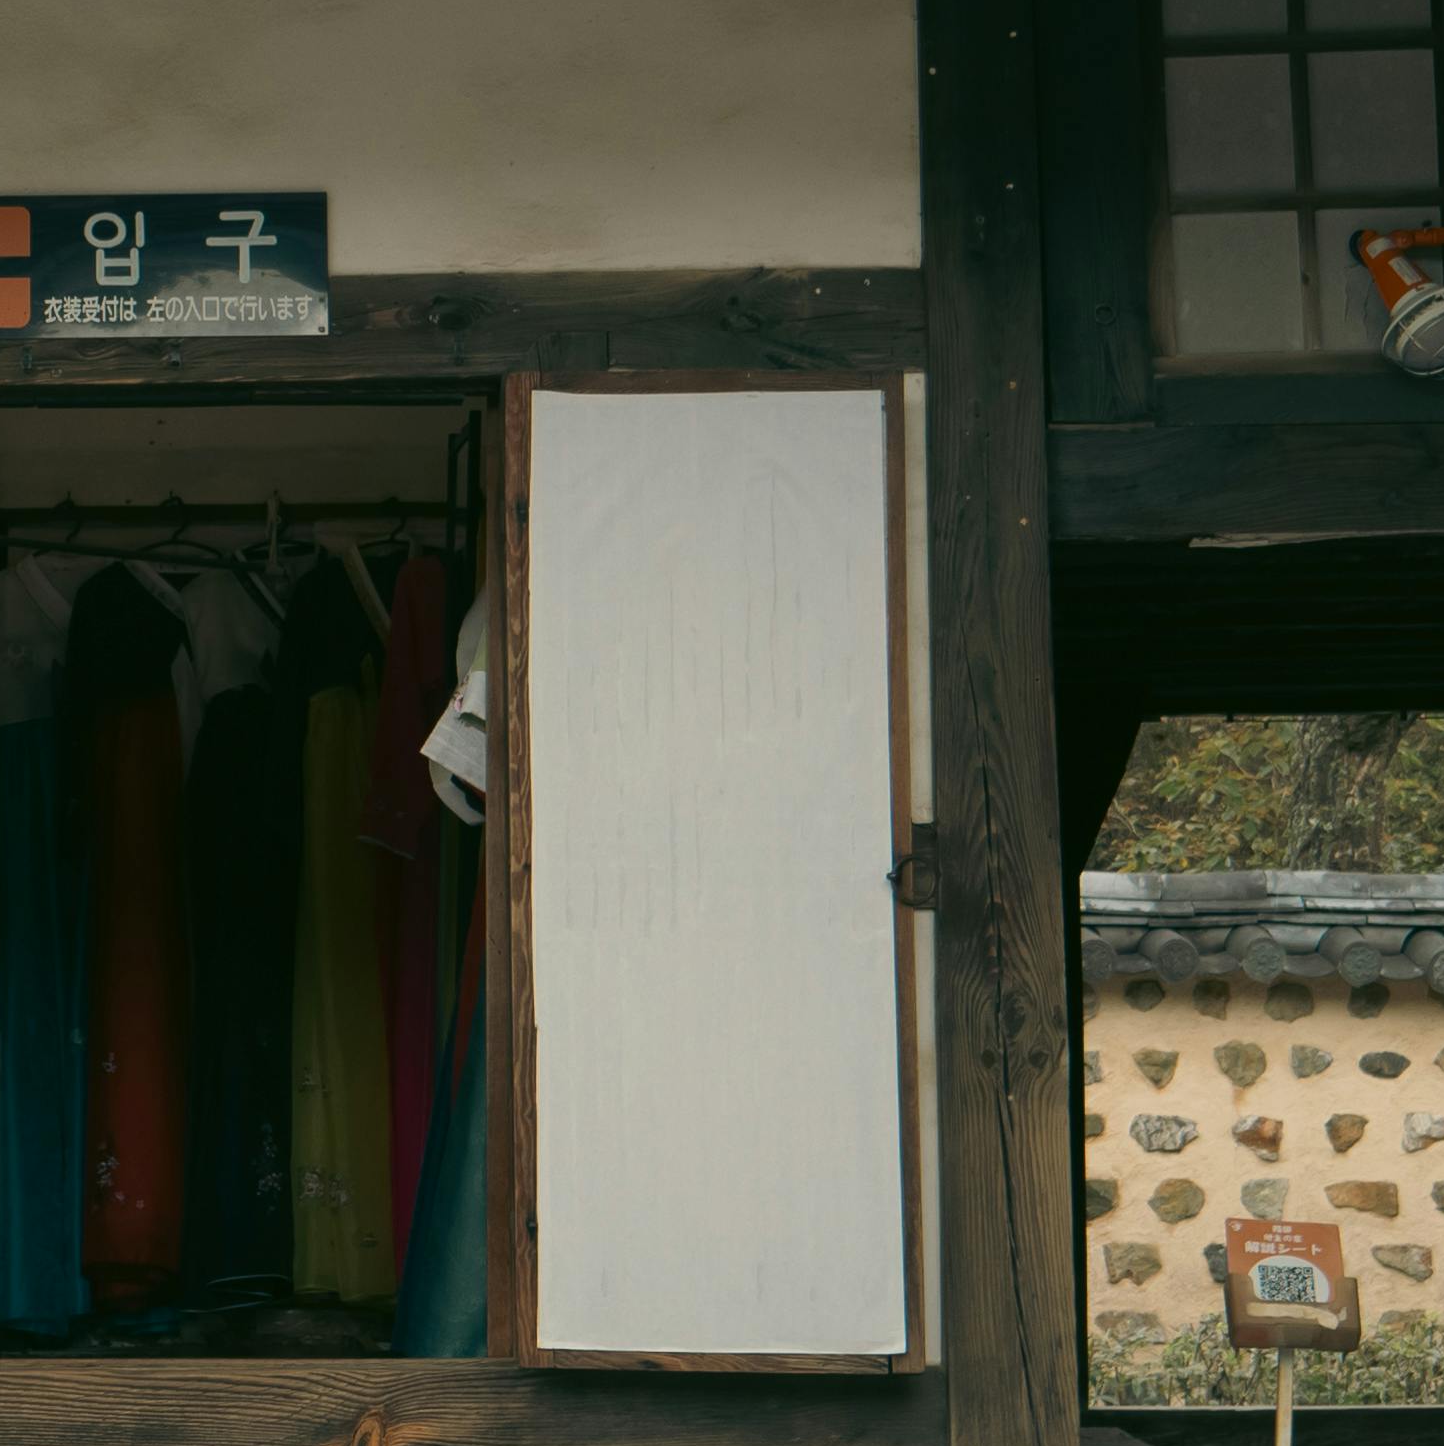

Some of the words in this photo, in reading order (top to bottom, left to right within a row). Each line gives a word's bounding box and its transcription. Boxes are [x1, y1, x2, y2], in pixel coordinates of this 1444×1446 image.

[84, 211, 278, 287] 입구
[44, 296, 137, 323] 衣装受付は
[146, 295, 313, 322] 左の入口で行います
